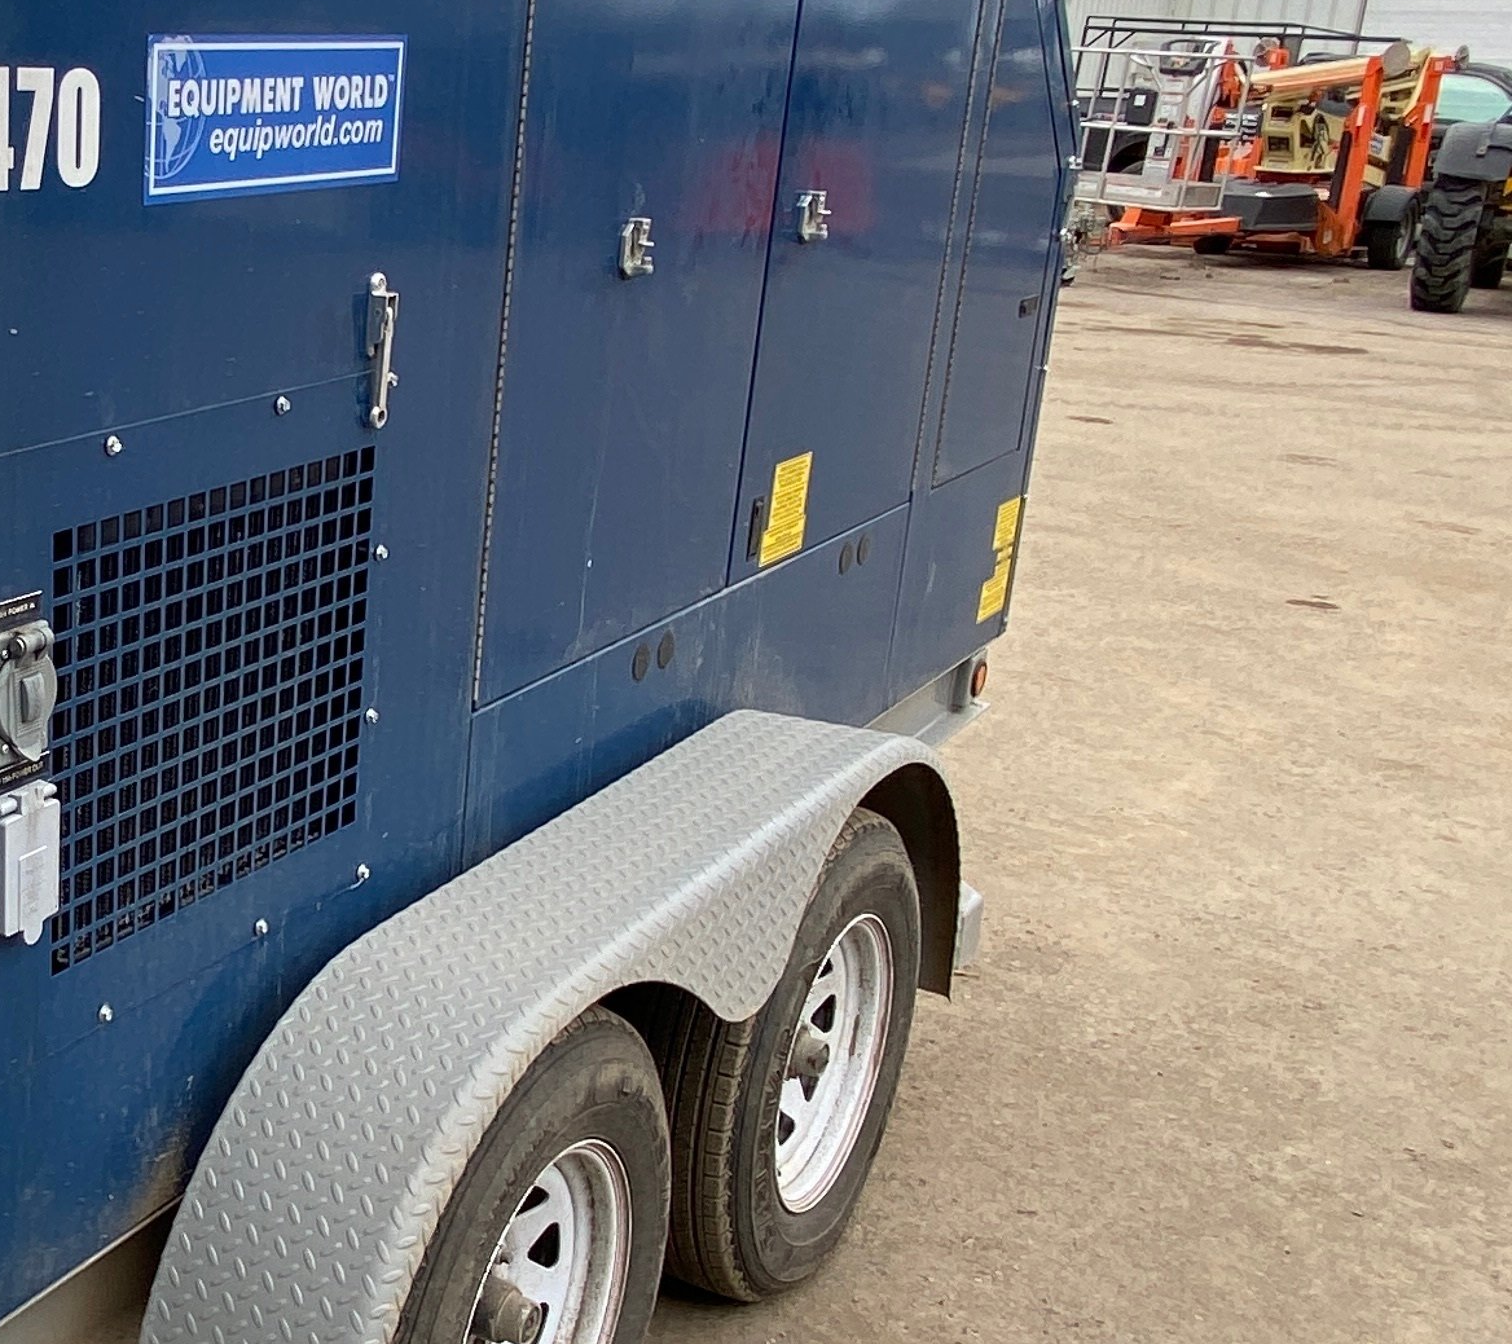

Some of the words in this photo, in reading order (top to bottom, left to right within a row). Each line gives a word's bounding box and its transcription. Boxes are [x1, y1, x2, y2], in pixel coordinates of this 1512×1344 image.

[166, 76, 305, 119] EQUIPMENT
[312, 73, 389, 112] WORLD
[208, 113, 384, 162] equipworld.com
